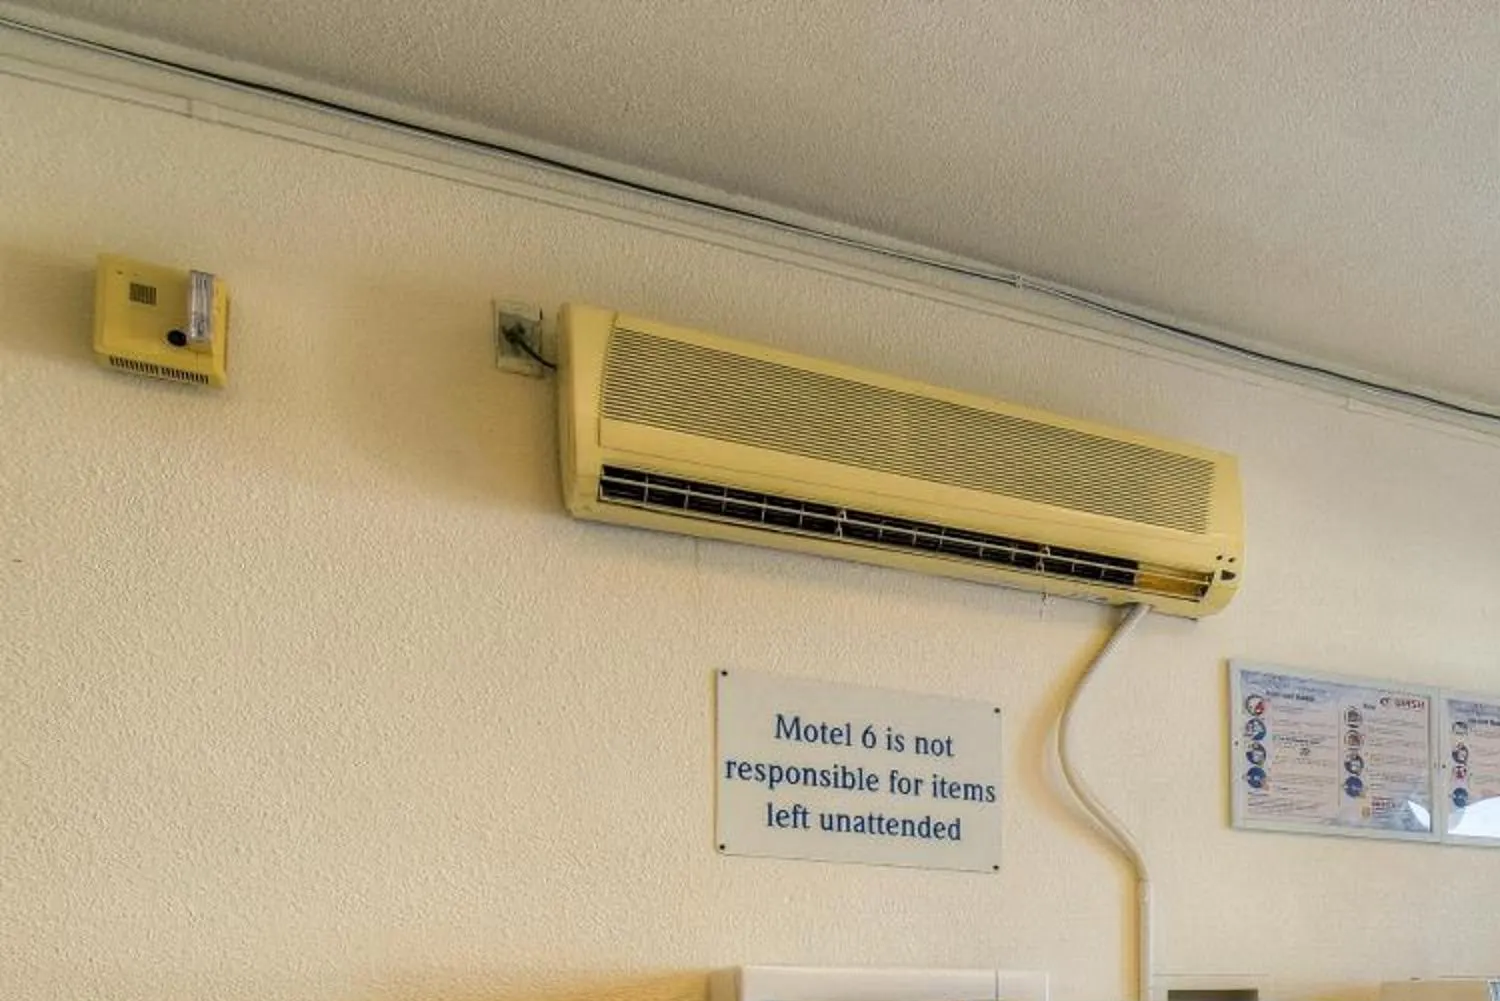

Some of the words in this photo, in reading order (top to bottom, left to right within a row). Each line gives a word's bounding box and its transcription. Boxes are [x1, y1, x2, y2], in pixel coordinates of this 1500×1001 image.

[774, 713, 852, 747] Motel
[861, 724, 877, 749] 6
[886, 727, 905, 752] is
[914, 735, 955, 757] not
[724, 758, 880, 792] responsible
[889, 769, 923, 797] for
[931, 774, 997, 803] items
[766, 802, 811, 829] left
[819, 811, 962, 841] unattended
